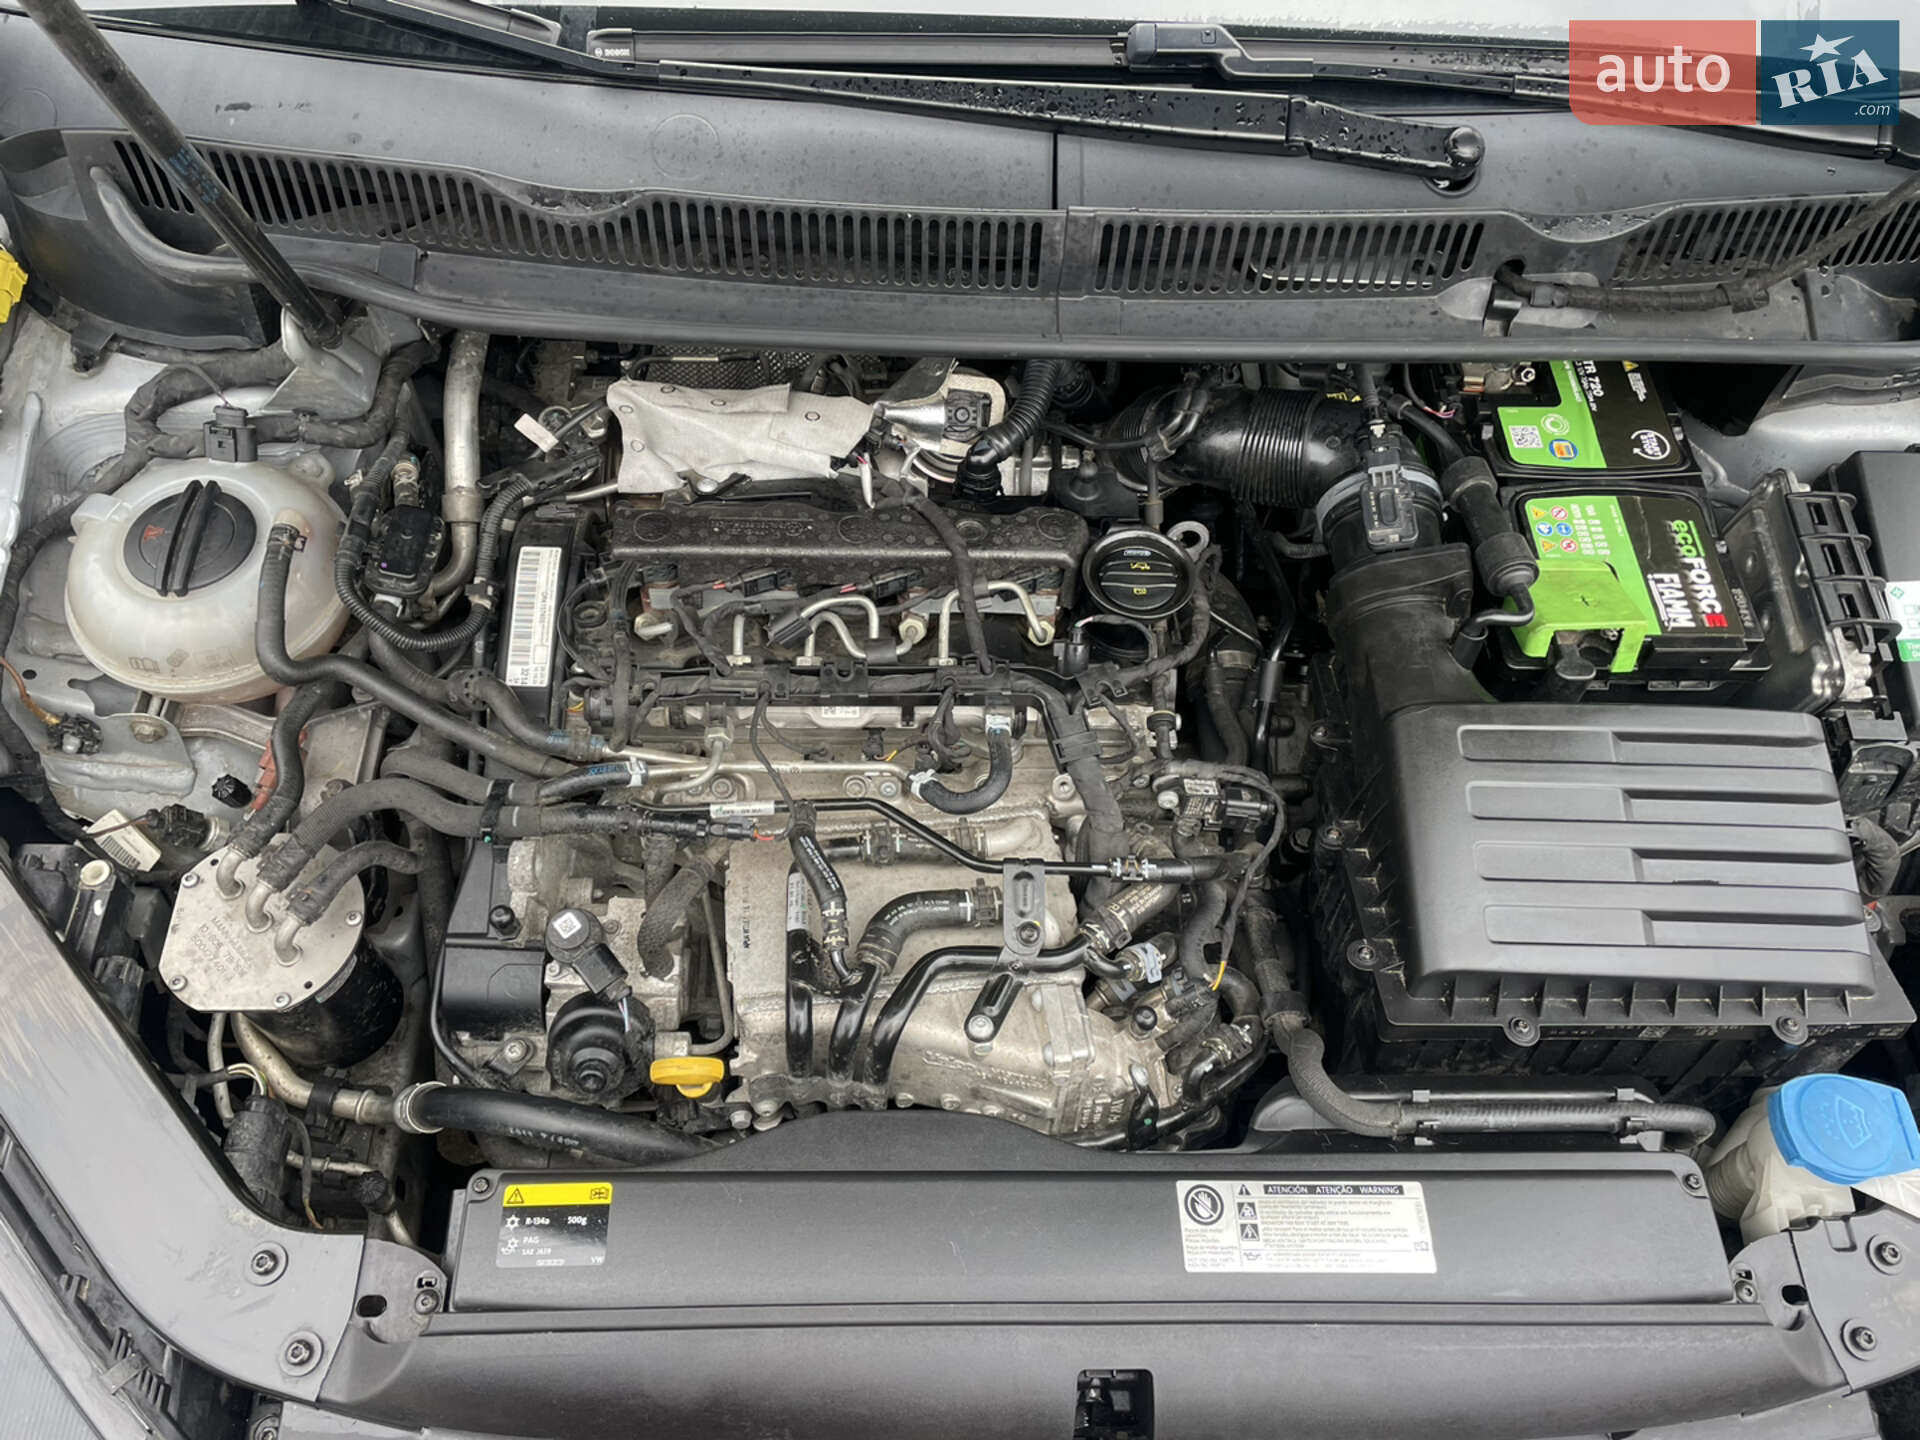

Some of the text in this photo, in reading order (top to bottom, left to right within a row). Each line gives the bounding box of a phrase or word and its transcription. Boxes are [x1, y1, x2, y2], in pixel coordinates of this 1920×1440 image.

[1588, 376, 1604, 397] 720
[1653, 573, 1696, 628] FIAMM
[1267, 1184, 1400, 1196] ATENCIÓN ATENÇÃO WARNING
[567, 1216, 588, 1226] 500g
